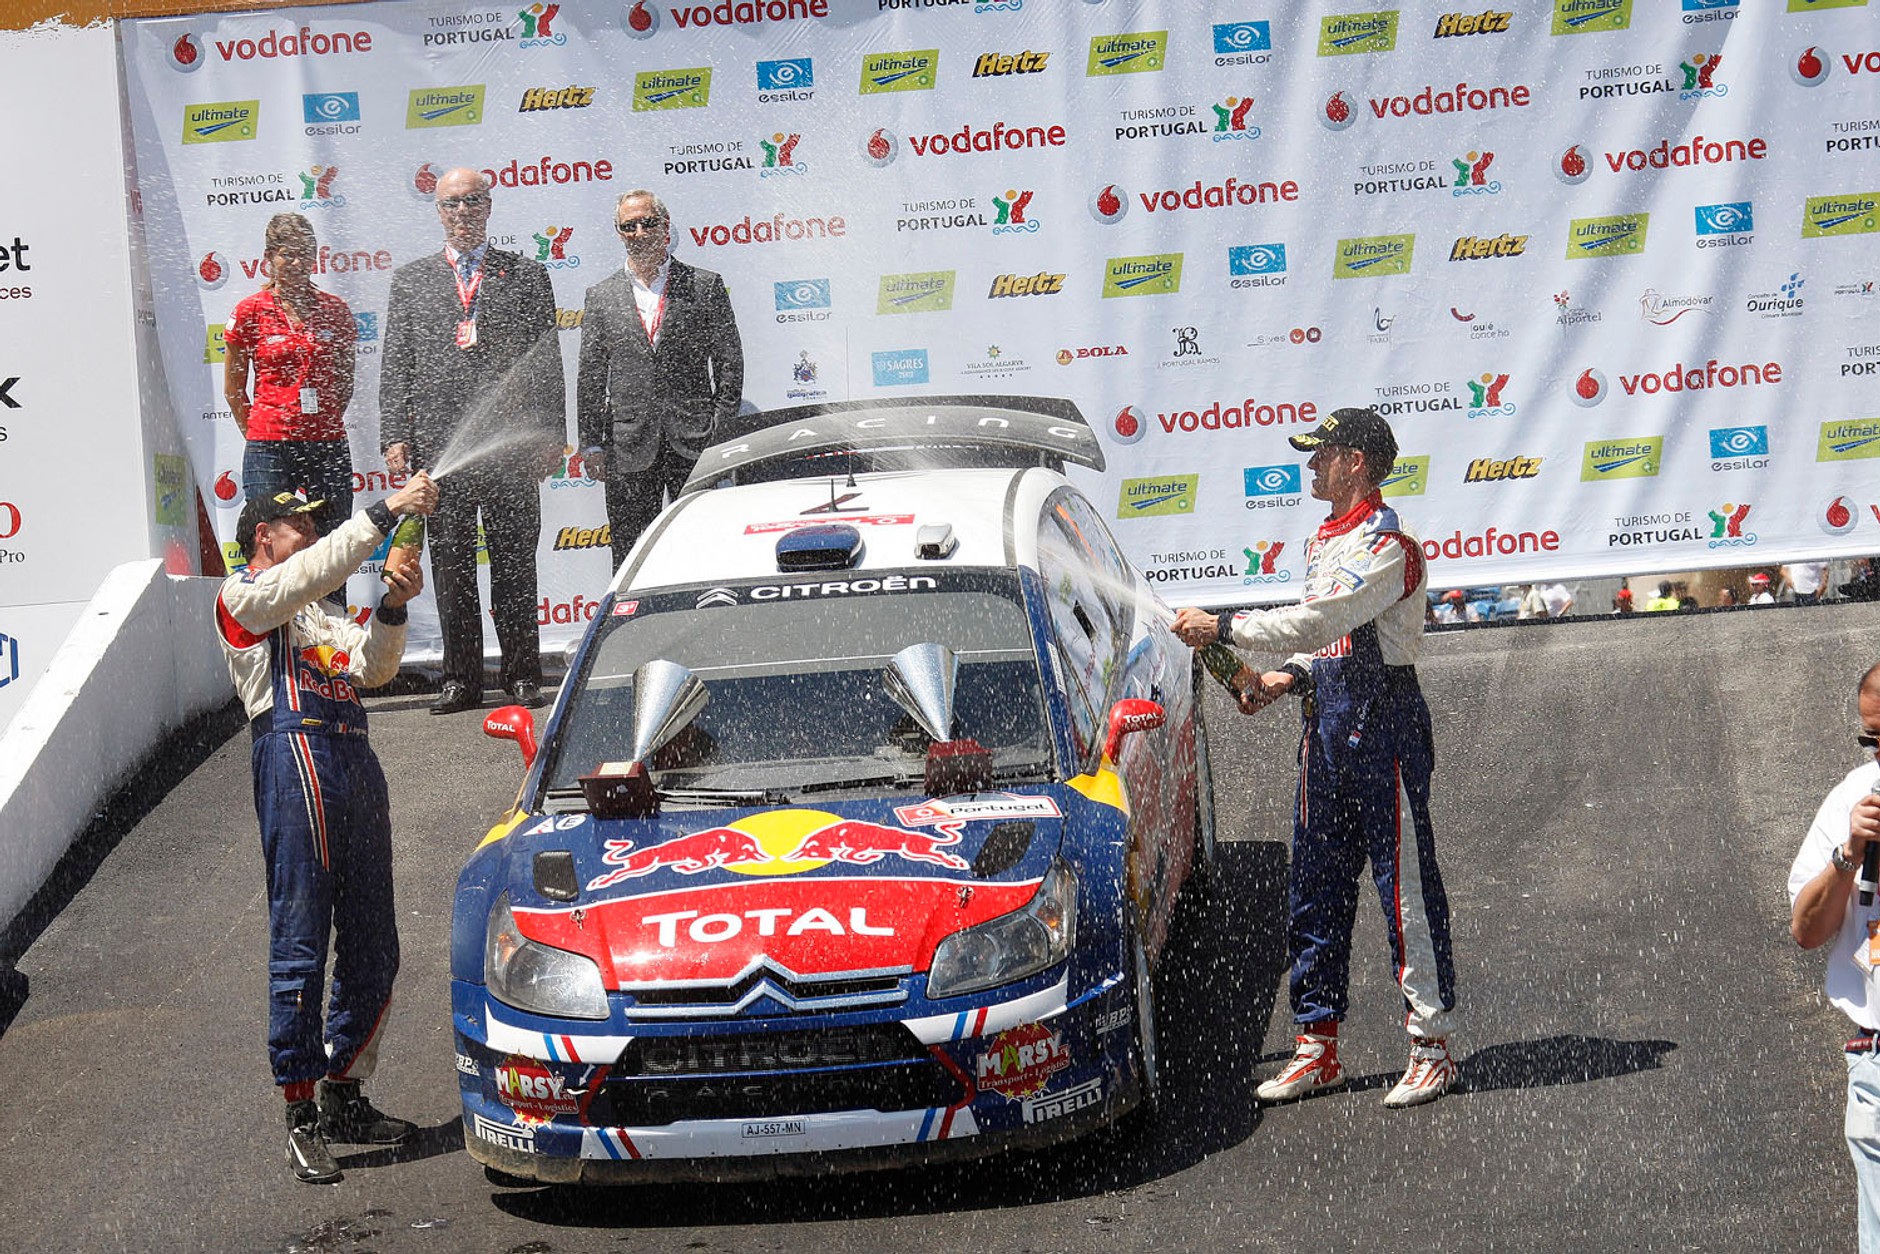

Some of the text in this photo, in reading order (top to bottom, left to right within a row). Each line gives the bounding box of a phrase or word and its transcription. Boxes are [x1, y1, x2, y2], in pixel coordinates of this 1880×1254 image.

[879, 0, 970, 11] PORTU
[1561, 0, 1623, 12] ultimate
[428, 12, 502, 27] TURISMO DE
[671, 0, 829, 28] vodafone
[1682, 9, 1741, 24] essilor
[1327, 17, 1389, 35] ultimate
[1434, 10, 1513, 38] Hertz
[216, 28, 373, 63] vodafone
[423, 28, 515, 47] PORTUGAL
[1097, 37, 1157, 54] ultimate
[869, 55, 929, 71] ultimate
[973, 50, 1052, 78] Hertz
[1214, 53, 1272, 67] essilor
[1586, 64, 1662, 80] TURISMO DE
[642, 74, 702, 90] ultimate
[1579, 79, 1675, 100] PORTUGAL
[416, 91, 475, 106] ultimate
[519, 86, 597, 112] Hertz
[758, 91, 815, 103] essilor
[1370, 83, 1530, 119] vodafone
[191, 107, 250, 122] ultimate
[1120, 105, 1196, 120] TURISMO DE
[305, 123, 361, 136] essilor
[1115, 120, 1208, 141] PORTUGAL
[670, 140, 743, 155] TURISMO DE
[909, 122, 1066, 157] vodafone
[1605, 136, 1767, 173] vodafone
[481, 156, 613, 190] odafone
[664, 155, 755, 175] PORTUGAL
[1360, 160, 1436, 176] TURISMO DE
[211, 172, 284, 188] TURISMO DE
[1354, 175, 1448, 196] PORTUGAL
[206, 187, 295, 207] PORTUGAL
[1140, 178, 1299, 214] vodafone
[903, 198, 976, 213] TURISMO DE
[1812, 199, 1875, 214] ultimate
[690, 213, 846, 247] vodafone
[897, 212, 988, 232] PORTUGAL
[1576, 221, 1637, 236] ultimate
[1344, 241, 1404, 257] ultimate
[1449, 234, 1529, 261] Hertz
[1696, 234, 1755, 249] essilor
[240, 246, 393, 279] vofone
[1113, 259, 1173, 276] ultimate
[886, 277, 945, 292] ultimate
[988, 272, 1068, 299] Hertz
[1231, 275, 1288, 290] essilor
[1747, 298, 1804, 312] Ourique
[776, 311, 832, 324] essilor
[1556, 312, 1602, 326] Alportel
[1257, 335, 1286, 346] Sves
[1471, 330, 1510, 340] conceho
[1076, 345, 1129, 359] BOLA
[887, 358, 924, 371] SAGRES
[1162, 359, 1196, 368] PORTUGAL
[1619, 360, 1782, 395] vodafone
[1375, 382, 1450, 397] TURISMO DE
[1369, 397, 1463, 415] PORTUGAL
[1157, 399, 1318, 433] vodafone
[721, 415, 1080, 459] RACING
[1827, 423, 1880, 439] ultimat
[1591, 443, 1652, 459] ultimate
[1464, 455, 1545, 483] Hertz
[1711, 457, 1770, 472] essilor
[1127, 481, 1188, 496] ultimate
[1245, 497, 1302, 509] essilor
[1614, 511, 1692, 527] TURISMO DE
[553, 523, 612, 551] Hert
[1423, 526, 1560, 561] odafone
[1609, 527, 1703, 547] PORTUGAL
[1151, 549, 1226, 564] TURISMO DE
[1146, 564, 1238, 582] PORTUGAL
[751, 575, 937, 599] CITROËN
[300, 669, 333, 700] Red
[1123, 711, 1159, 724] TOTAL
[487, 720, 516, 732] TOTAL
[950, 803, 1049, 815] Portugal
[642, 907, 895, 947] TOTAL
[979, 1029, 1063, 1078] MARSY
[495, 1067, 562, 1100] MARSY
[1022, 1077, 1102, 1124] PIRELLI
[473, 1113, 536, 1153] PIRELLI
[746, 1123, 801, 1136] AJ-557-MN
